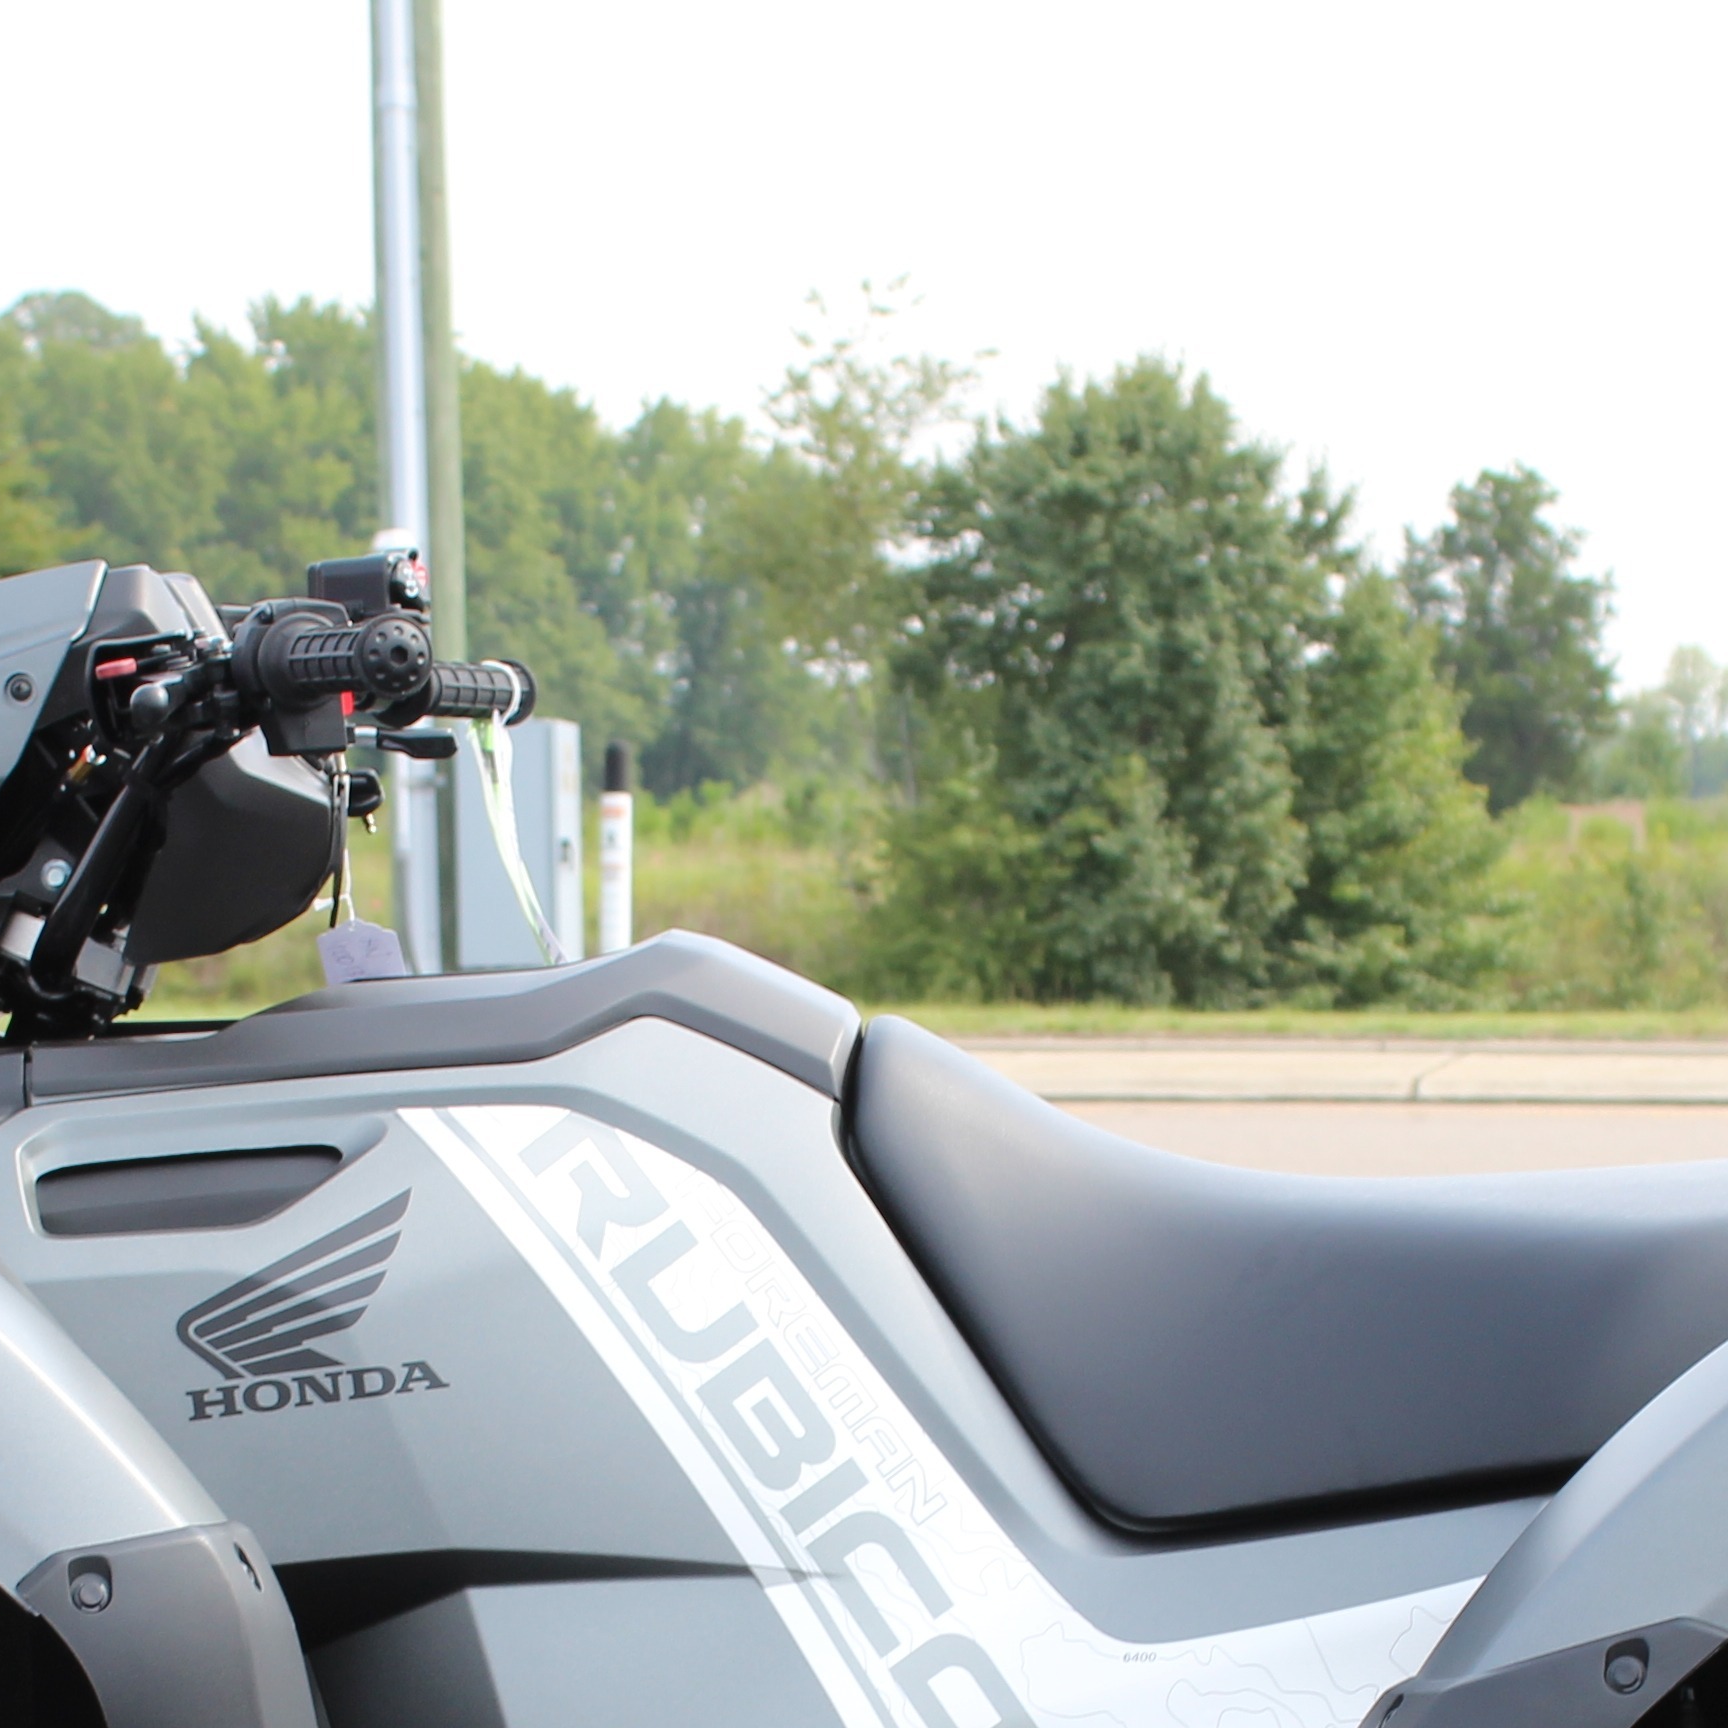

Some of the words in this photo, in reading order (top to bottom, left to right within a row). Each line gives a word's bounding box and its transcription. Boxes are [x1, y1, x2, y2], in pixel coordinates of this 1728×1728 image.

[674, 1171, 948, 1526] FOREMAN
[185, 1359, 450, 1421] HONDA
[1122, 1651, 1157, 1664] 6400
